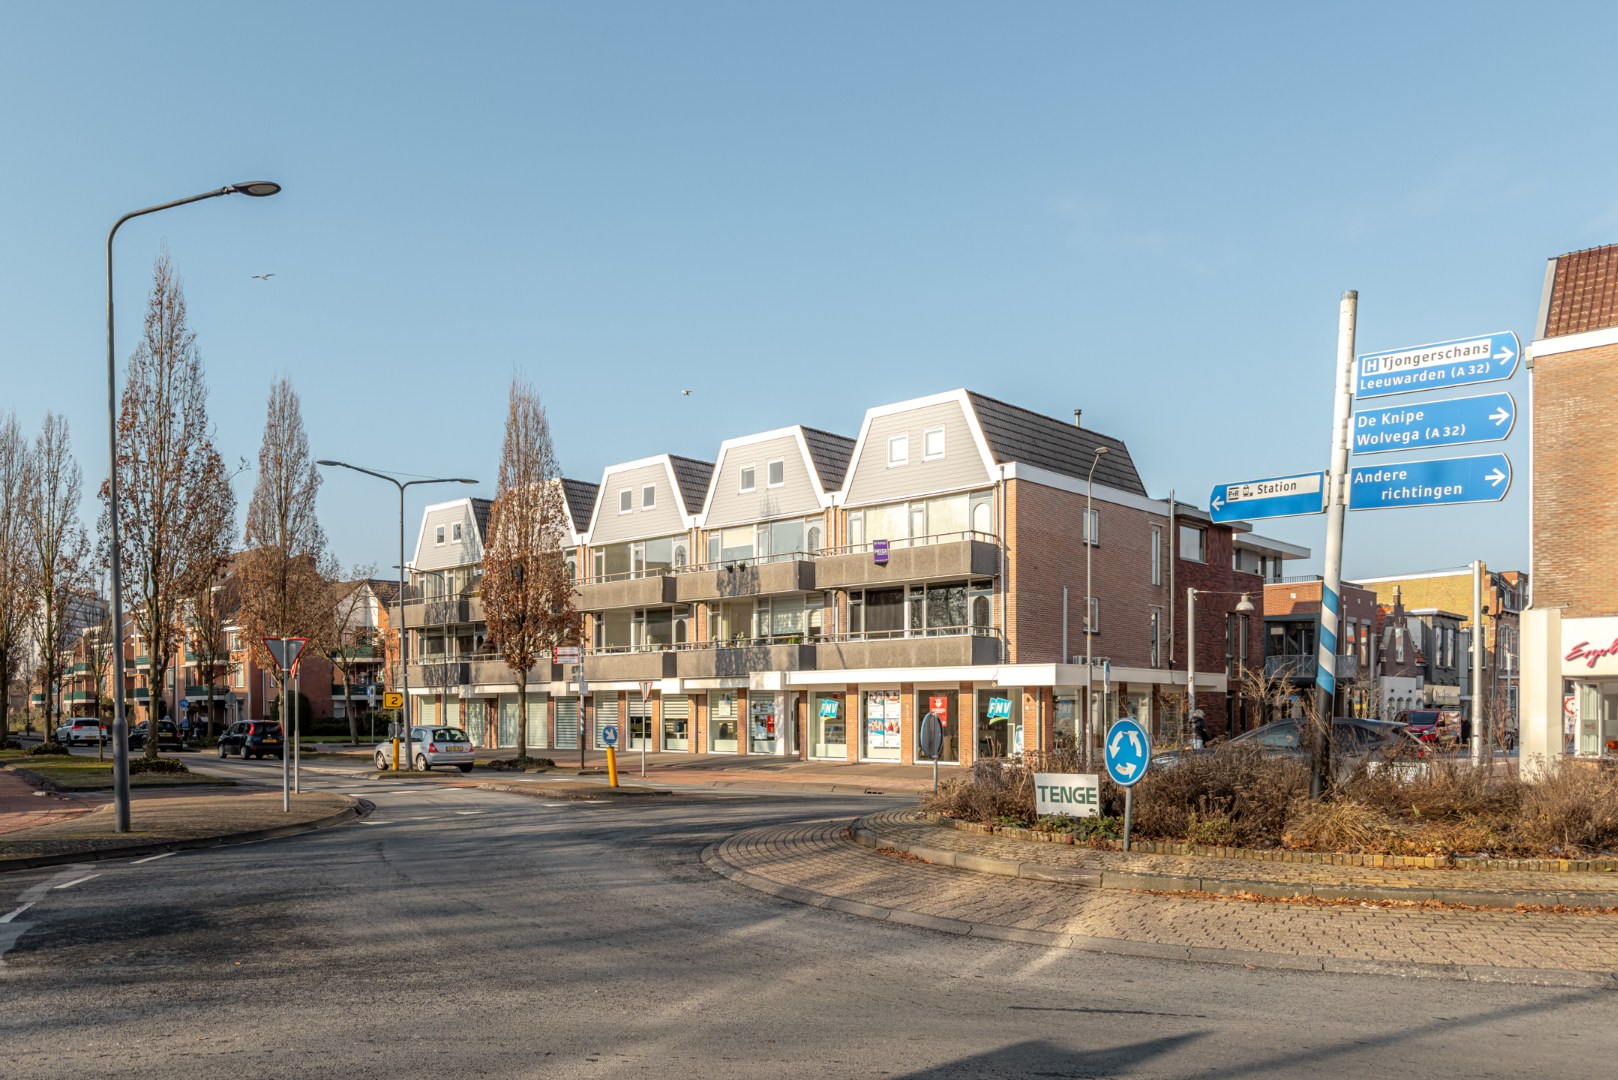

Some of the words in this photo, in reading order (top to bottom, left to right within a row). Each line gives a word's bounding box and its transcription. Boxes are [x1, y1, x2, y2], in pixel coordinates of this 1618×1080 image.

[1382, 343, 1489, 370] Tjongerschans
[1360, 368, 1446, 390] Leeuwarden
[1358, 416, 1376, 428] De
[1382, 411, 1424, 425] Knipe
[1357, 430, 1420, 446] Wolvega
[1354, 469, 1408, 484] Andere
[1257, 481, 1297, 495] Station
[1381, 485, 1462, 500] richtingen
[391, 696, 398, 705] 2
[988, 702, 1011, 714] FNV
[1037, 785, 1098, 804] TENGE
